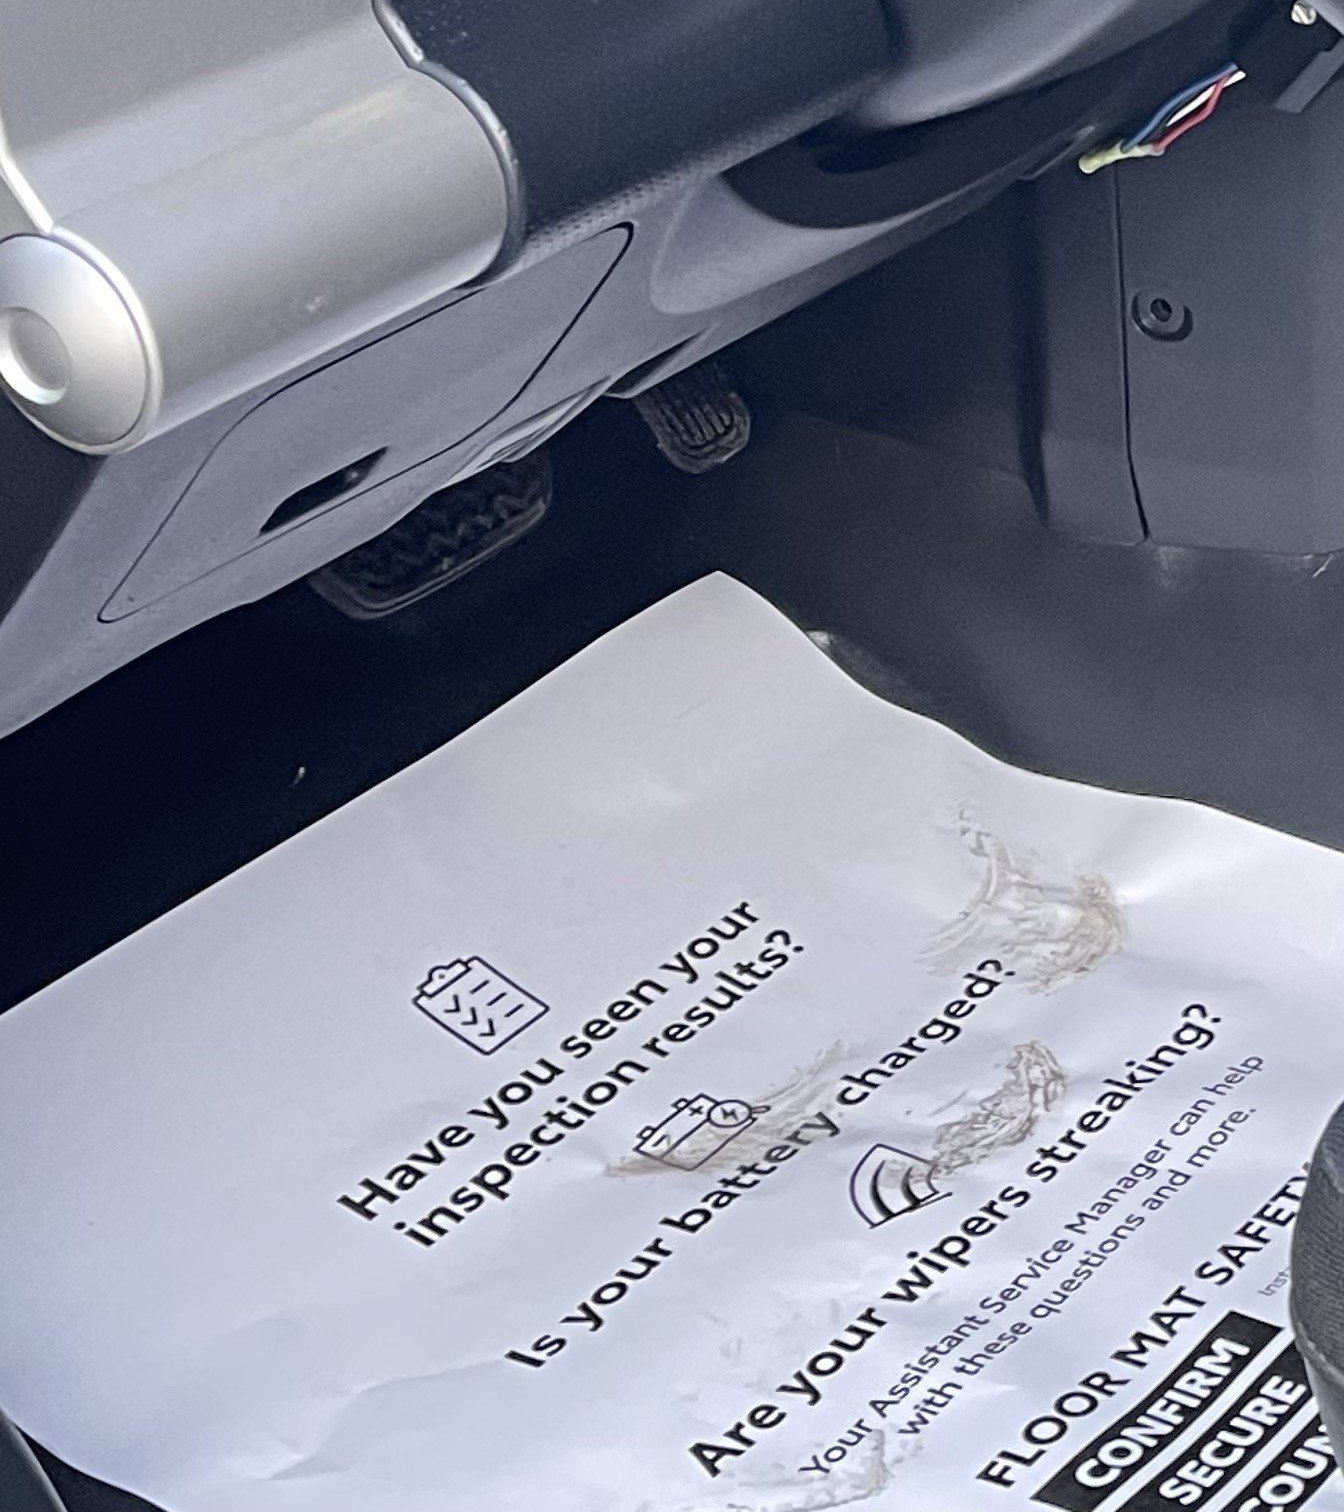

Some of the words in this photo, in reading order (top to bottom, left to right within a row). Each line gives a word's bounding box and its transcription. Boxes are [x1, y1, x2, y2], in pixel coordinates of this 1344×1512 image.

[336, 1125, 476, 1221] Have
[466, 1057, 566, 1131] you
[559, 979, 669, 1060] seen
[658, 901, 760, 985] your
[393, 1060, 650, 1247] inspection
[641, 929, 804, 1059] results?
[504, 1334, 568, 1368] Is
[559, 1237, 673, 1333] your
[658, 1111, 841, 1234] battery
[836, 959, 1016, 1106] charged?
[688, 1404, 788, 1478] Are
[775, 1306, 888, 1407] your
[880, 1185, 1032, 1303] wipers
[1025, 1003, 1222, 1183] streaking?
[797, 1418, 874, 1474] Your
[868, 1315, 990, 1419] Assistant
[979, 1239, 1075, 1314] Service
[1063, 1138, 1172, 1235] Manager
[1169, 1099, 1216, 1136] can
[1202, 1054, 1264, 1096] help
[897, 1381, 963, 1435] with
[953, 1322, 1033, 1376] these
[1029, 1213, 1146, 1319] questions
[1141, 1168, 1192, 1211] and
[1186, 1107, 1255, 1168] more.
[975, 1371, 1132, 1488] FLOOR
[1110, 1285, 1207, 1369] MAT
[1074, 1337, 1250, 1489] CONFIRM
[1158, 1374, 1307, 1506] SECURE
